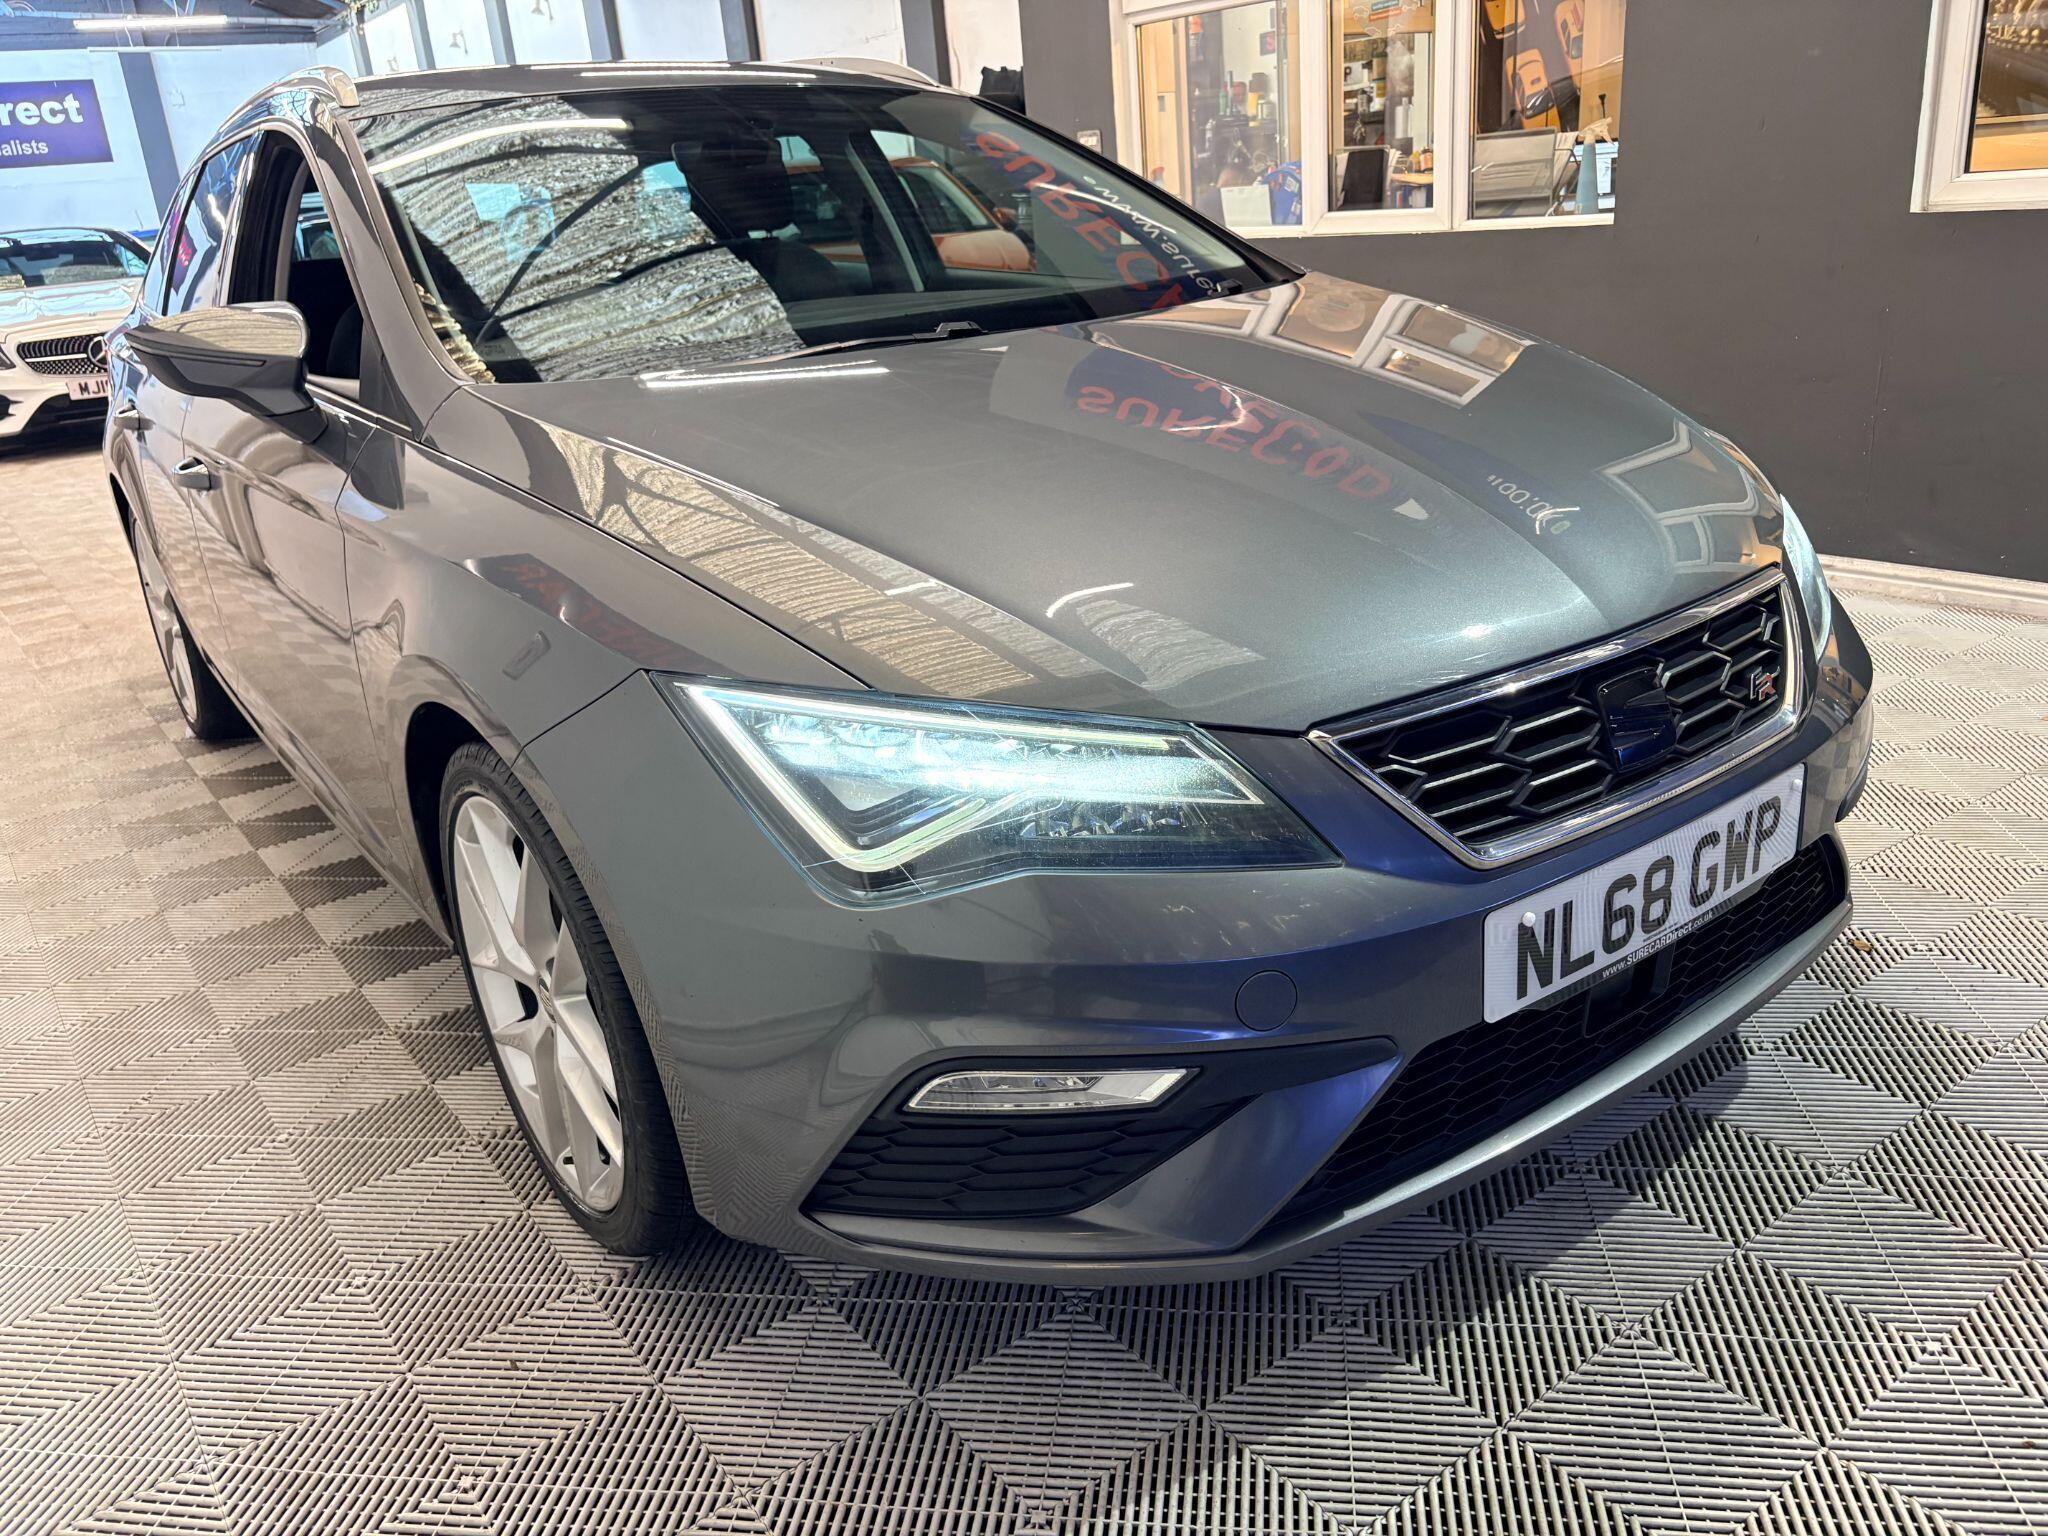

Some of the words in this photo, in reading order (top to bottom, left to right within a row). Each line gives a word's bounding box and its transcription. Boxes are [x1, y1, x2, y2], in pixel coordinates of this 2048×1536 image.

[0, 140, 49, 157] alists
[1516, 855, 1675, 1001] NL68
[1689, 795, 1782, 908] GWP
[1601, 910, 1714, 979] www.SURECARDirect.co.uk
